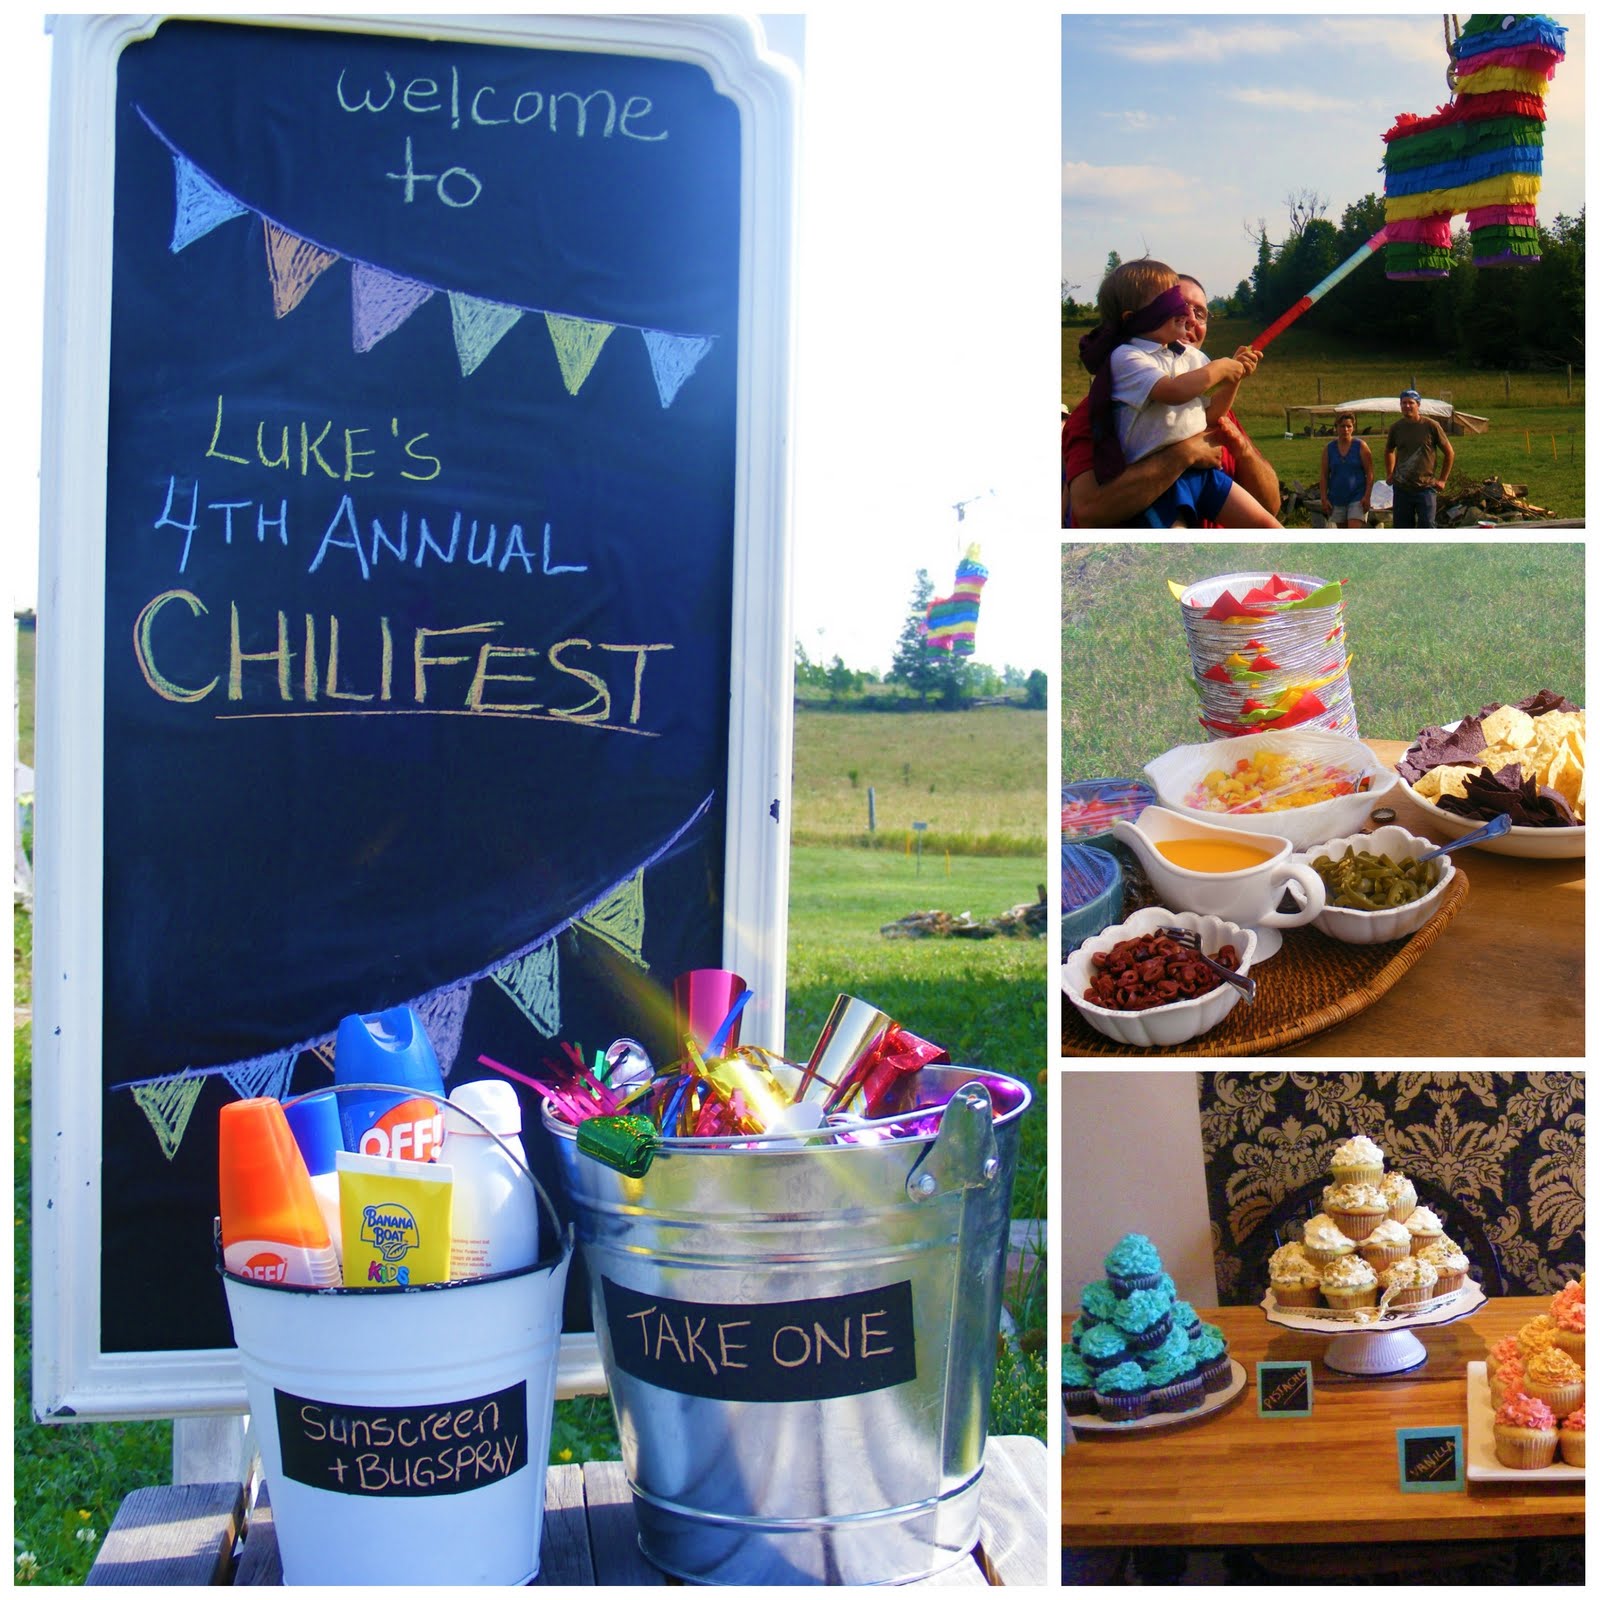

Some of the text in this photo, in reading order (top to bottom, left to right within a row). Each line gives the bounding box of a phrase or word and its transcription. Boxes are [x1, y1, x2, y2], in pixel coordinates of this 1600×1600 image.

[336, 66, 669, 142] welcome
[386, 135, 483, 208] to
[205, 394, 442, 482] LUKE'S
[153, 474, 589, 580] 4TH ANNUAL
[133, 588, 675, 723] CHILIFEST
[359, 1113, 444, 1160] OFF!
[365, 1208, 414, 1230] BANANA
[373, 1226, 406, 1245] BOAT
[626, 1306, 896, 1375] TAKE ONE
[300, 1401, 500, 1449] Sunscreen
[1409, 1438, 1456, 1477] VANILLA
